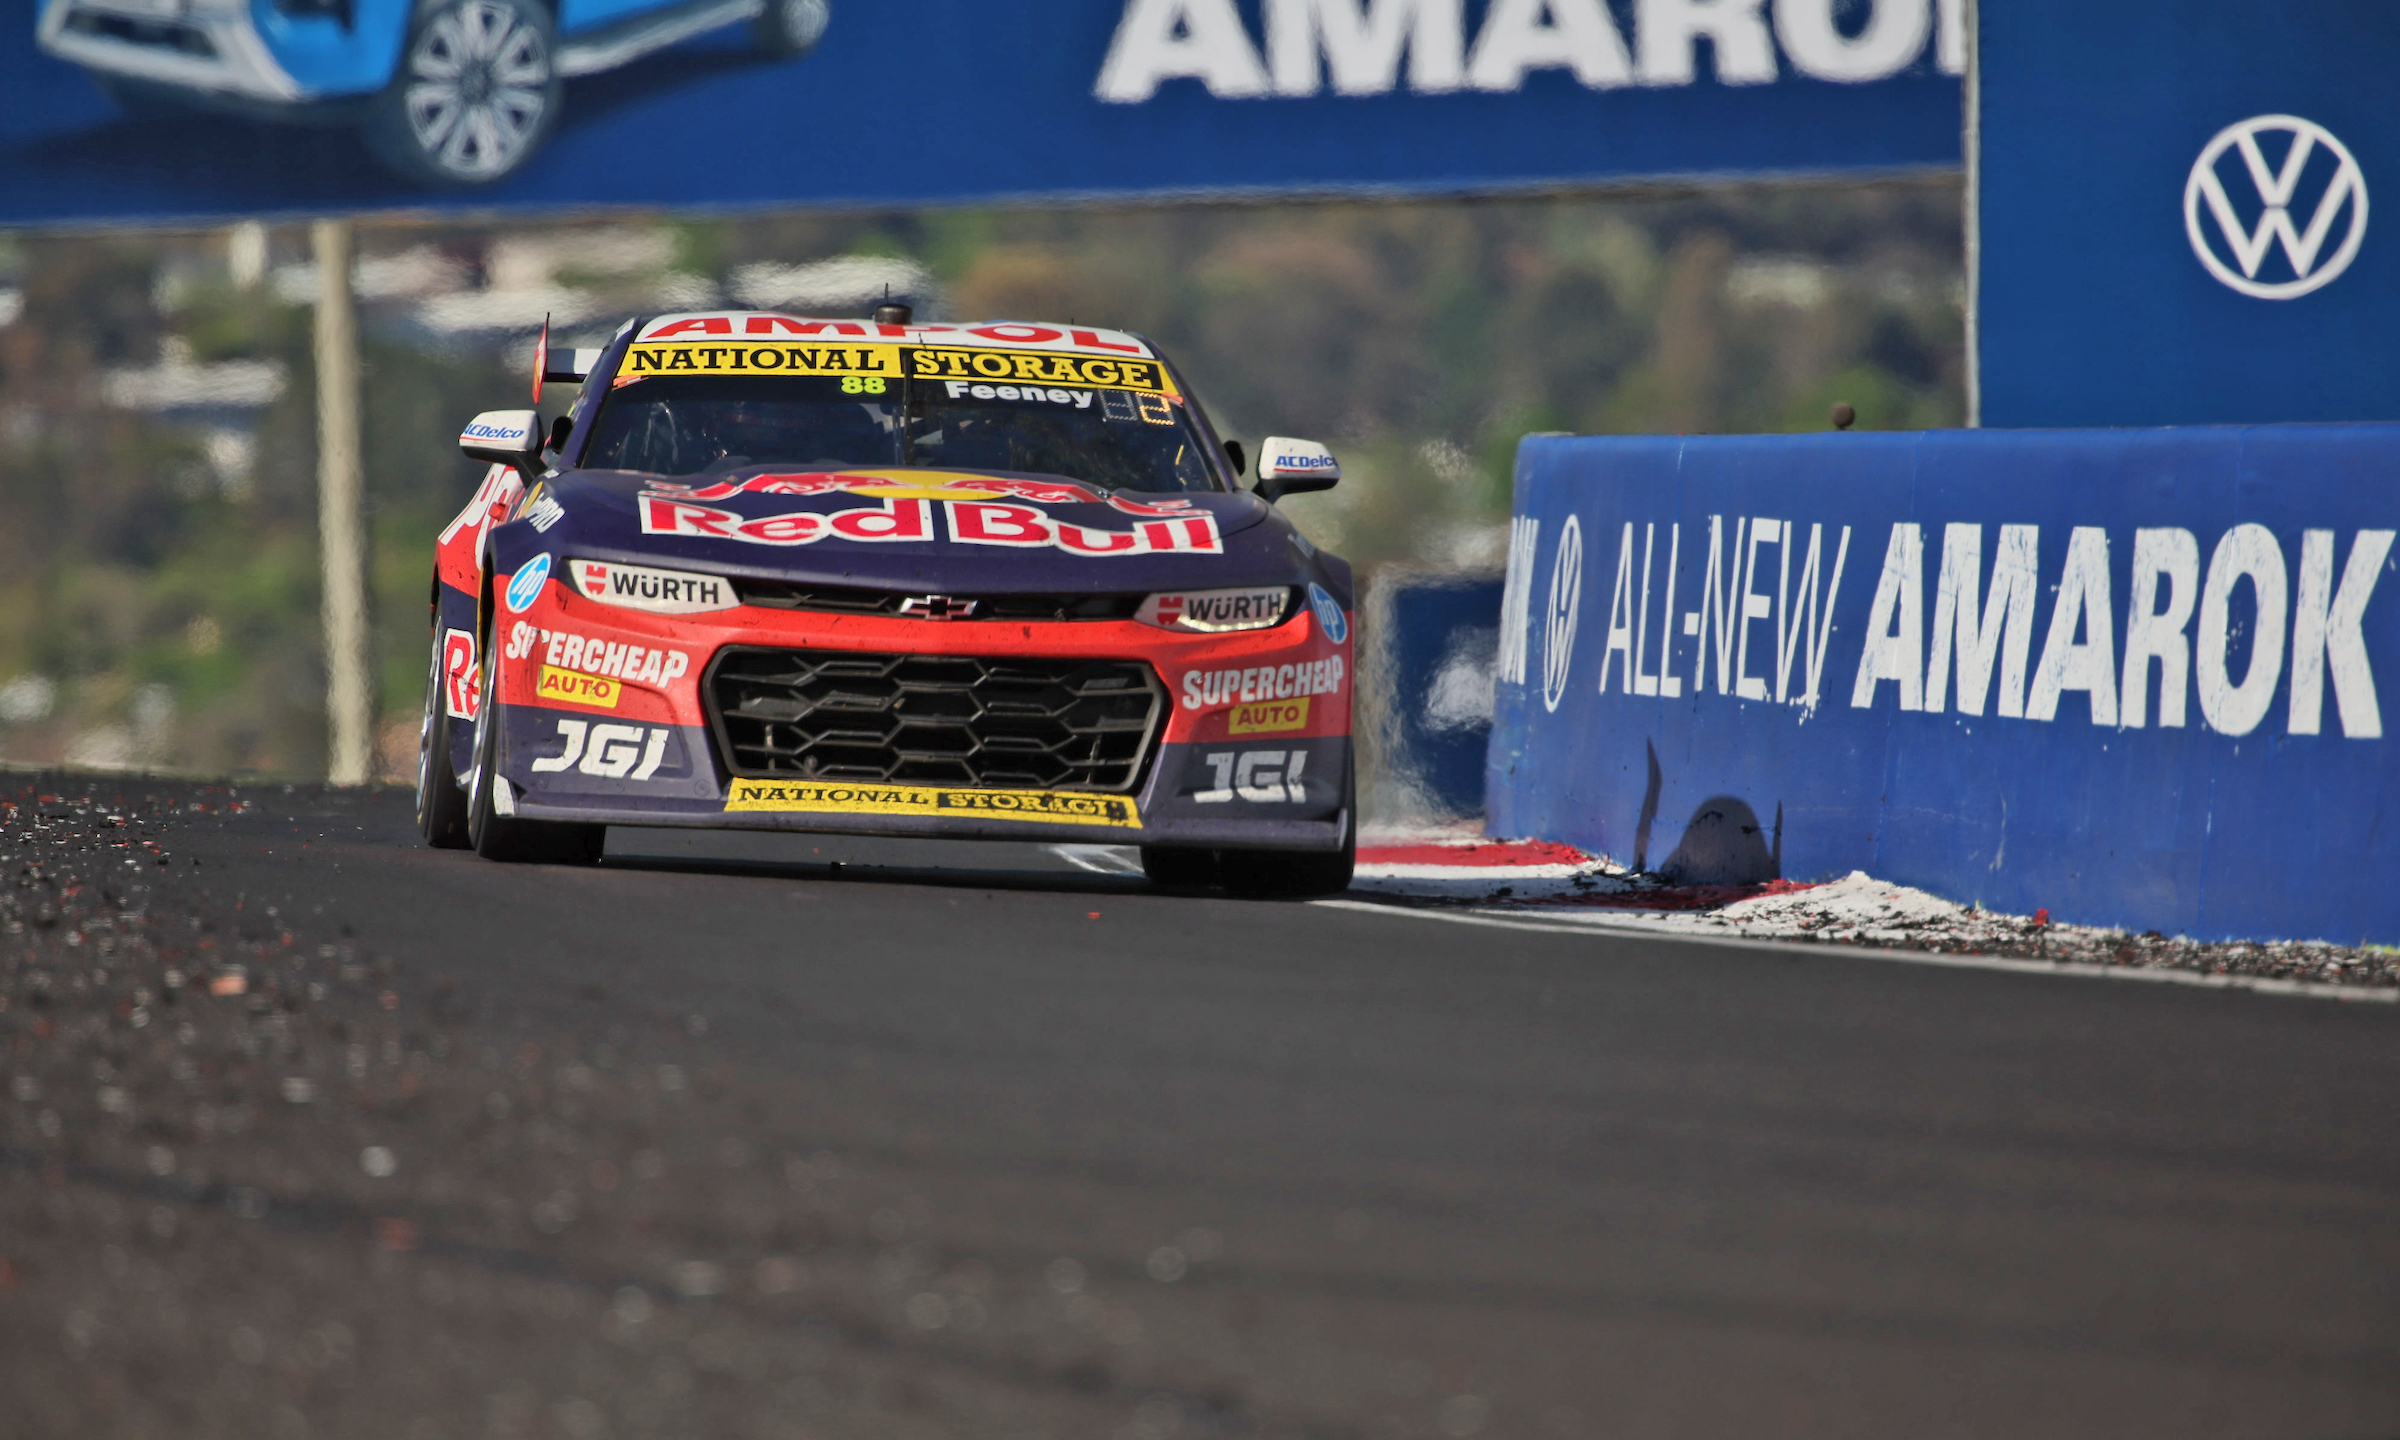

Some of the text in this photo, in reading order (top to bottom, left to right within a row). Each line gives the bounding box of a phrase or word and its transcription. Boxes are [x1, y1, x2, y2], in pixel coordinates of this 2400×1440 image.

[1094, 0, 1966, 104] AMARO
[643, 316, 1141, 353] AMPOL
[632, 348, 1152, 388] NATIONAL STORAGE
[840, 376, 887, 395] 88
[944, 380, 1093, 409] Feeney
[639, 494, 935, 547] Red
[943, 498, 1224, 557] Bull
[1599, 514, 1852, 708] ALL-NEW
[1850, 522, 2397, 739] AMAROK
[543, 674, 612, 699] AUTO
[1182, 654, 1345, 710] SUPERCHEAP
[1237, 705, 1300, 727] AUTO
[531, 719, 669, 781] JGI
[738, 786, 930, 805] NATIONAL
[1193, 750, 1308, 804] JGI
